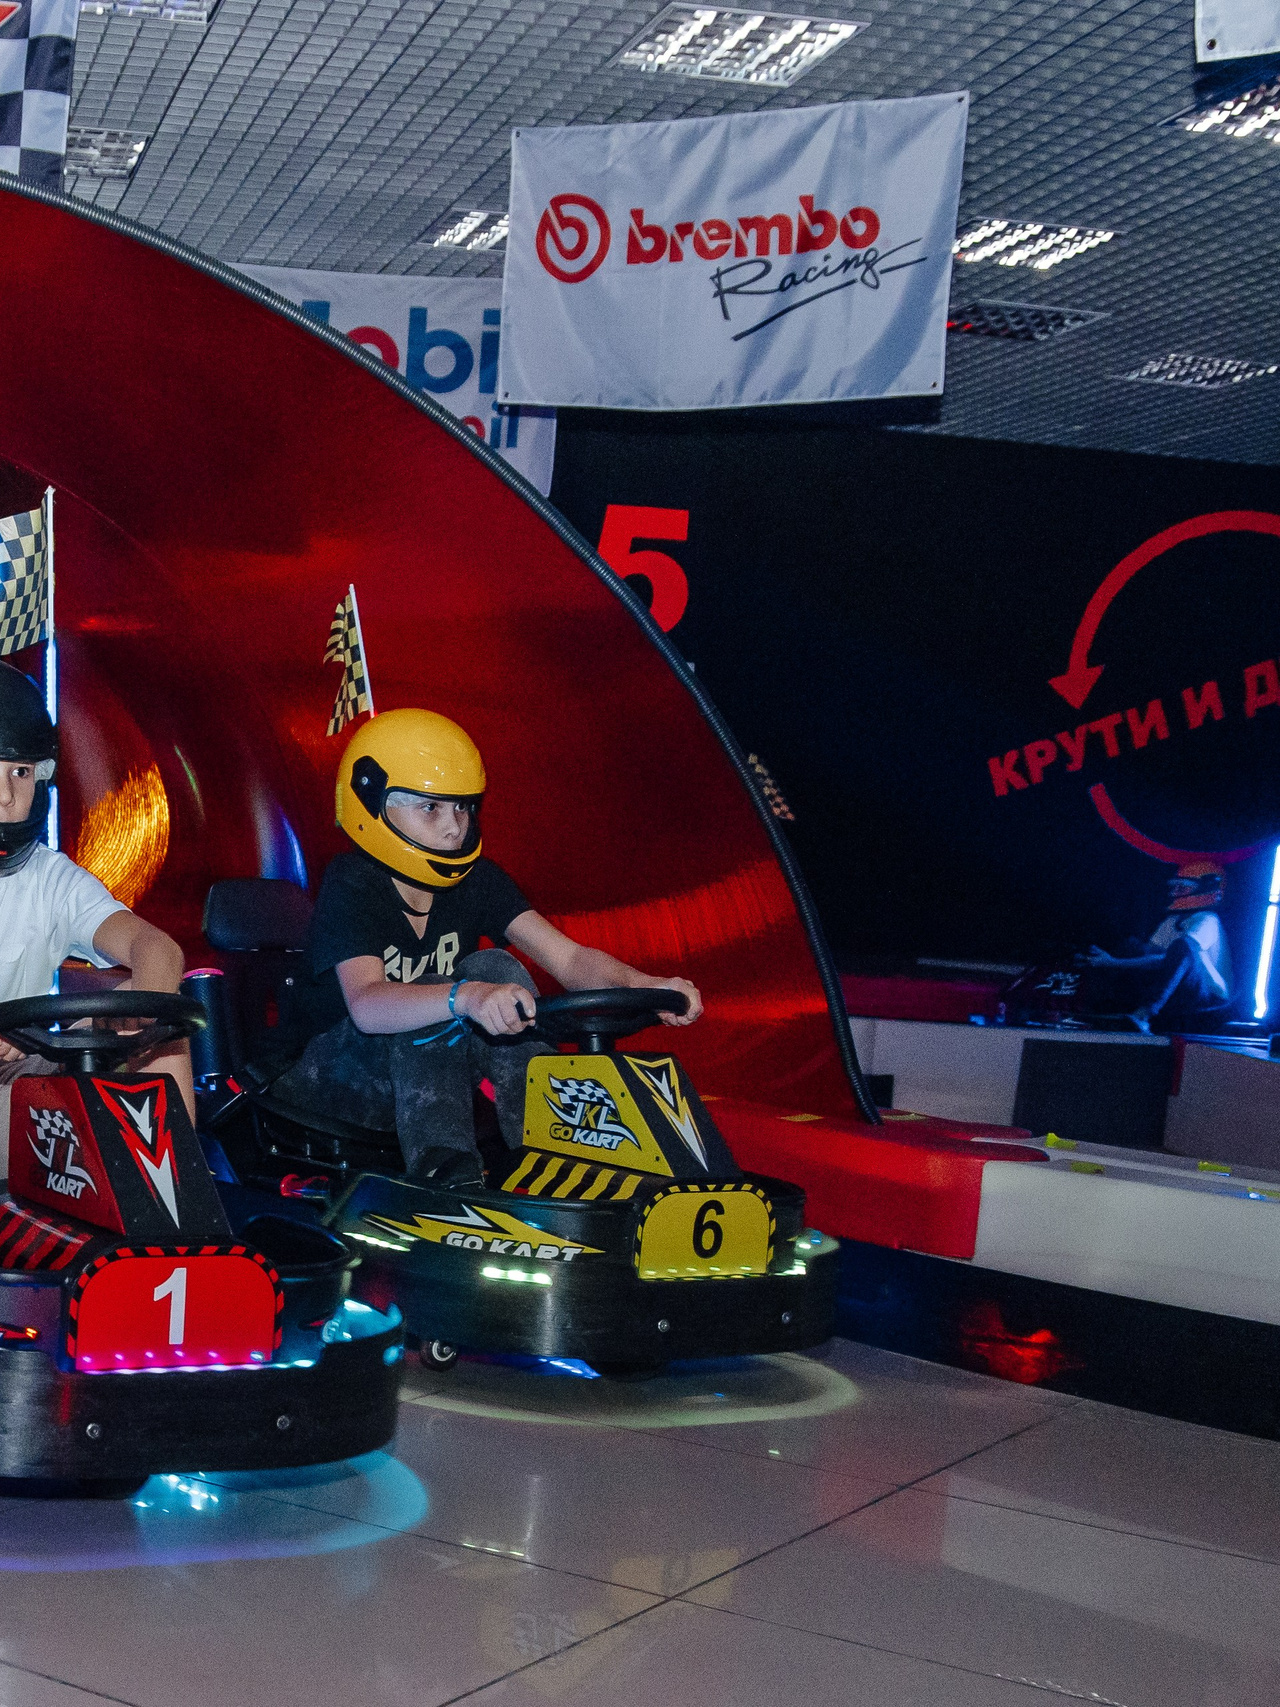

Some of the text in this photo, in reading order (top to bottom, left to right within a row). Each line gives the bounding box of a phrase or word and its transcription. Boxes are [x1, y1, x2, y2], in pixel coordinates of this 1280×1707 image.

[626, 194, 880, 264] brembo
[710, 238, 923, 321] Racing
[302, 299, 501, 394] obi
[597, 503, 690, 633] 5
[987, 698, 1169, 797] КРУТИ
[1182, 680, 1224, 729] И
[46, 1171, 87, 1199] KART
[446, 1231, 586, 1262] GO KART
[691, 1199, 727, 1259] 6
[153, 1267, 188, 1345] 1
